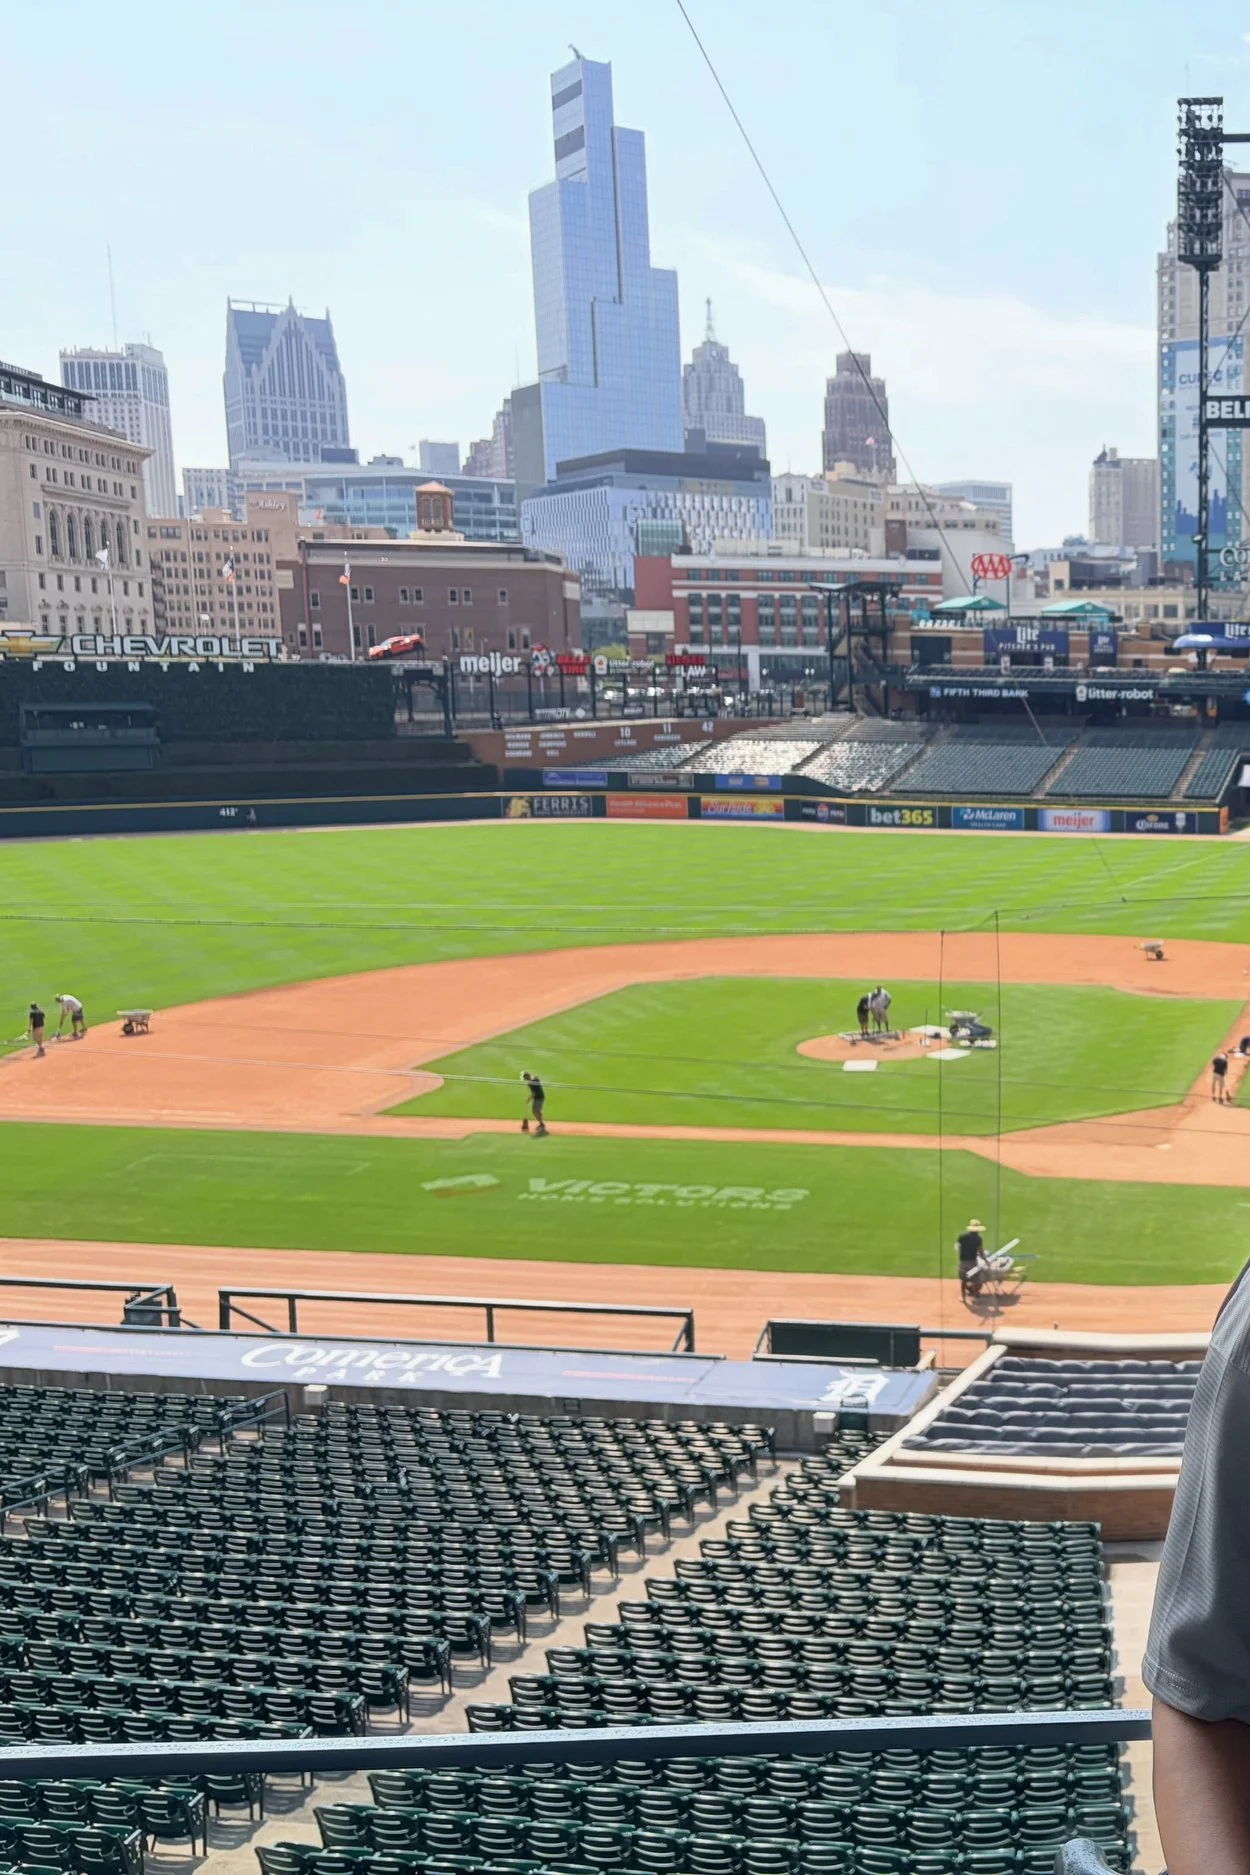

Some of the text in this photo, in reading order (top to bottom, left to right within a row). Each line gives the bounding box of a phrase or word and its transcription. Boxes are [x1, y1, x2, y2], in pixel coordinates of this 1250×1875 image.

[974, 554, 1010, 579] AAA
[1016, 627, 1040, 643] Lite
[1224, 623, 1248, 638] Lite
[72, 634, 284, 658] CHEVROLET
[33, 661, 255, 672] FOUNTAIN
[460, 652, 522, 676] meijer
[943, 688, 1029, 698] FIFTH THIRD BANK
[533, 797, 588, 810] FERRIS
[870, 806, 934, 826] bet365
[973, 809, 1017, 822] McLaren
[1053, 811, 1096, 829] meijer
[1136, 819, 1170, 832] Corona
[527, 1177, 811, 1202] VICTORS
[294, 1366, 427, 1384] PARK
